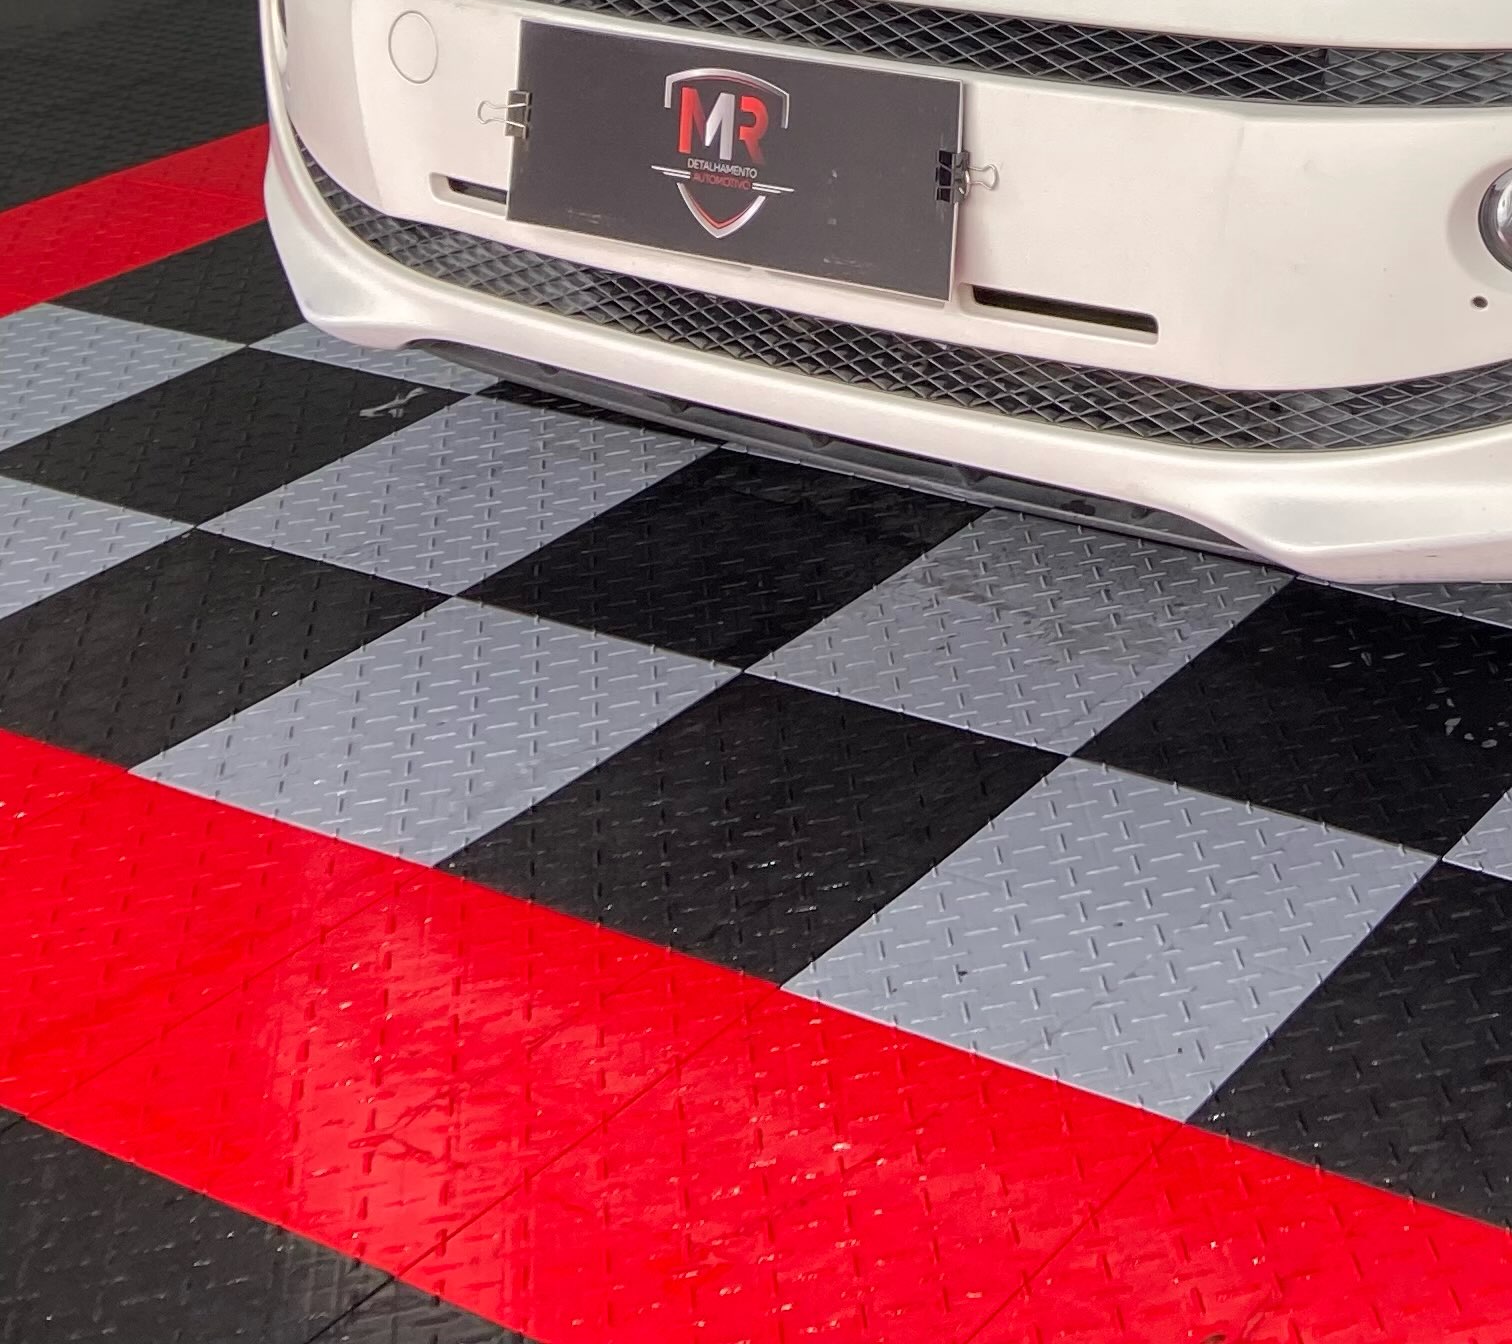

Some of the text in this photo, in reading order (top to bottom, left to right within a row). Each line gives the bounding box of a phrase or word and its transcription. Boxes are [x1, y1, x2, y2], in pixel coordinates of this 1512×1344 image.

[678, 86, 768, 166] MR
[687, 158, 758, 179] DETALHAMENTO
[692, 172, 752, 191] AUTOMOTIVO
